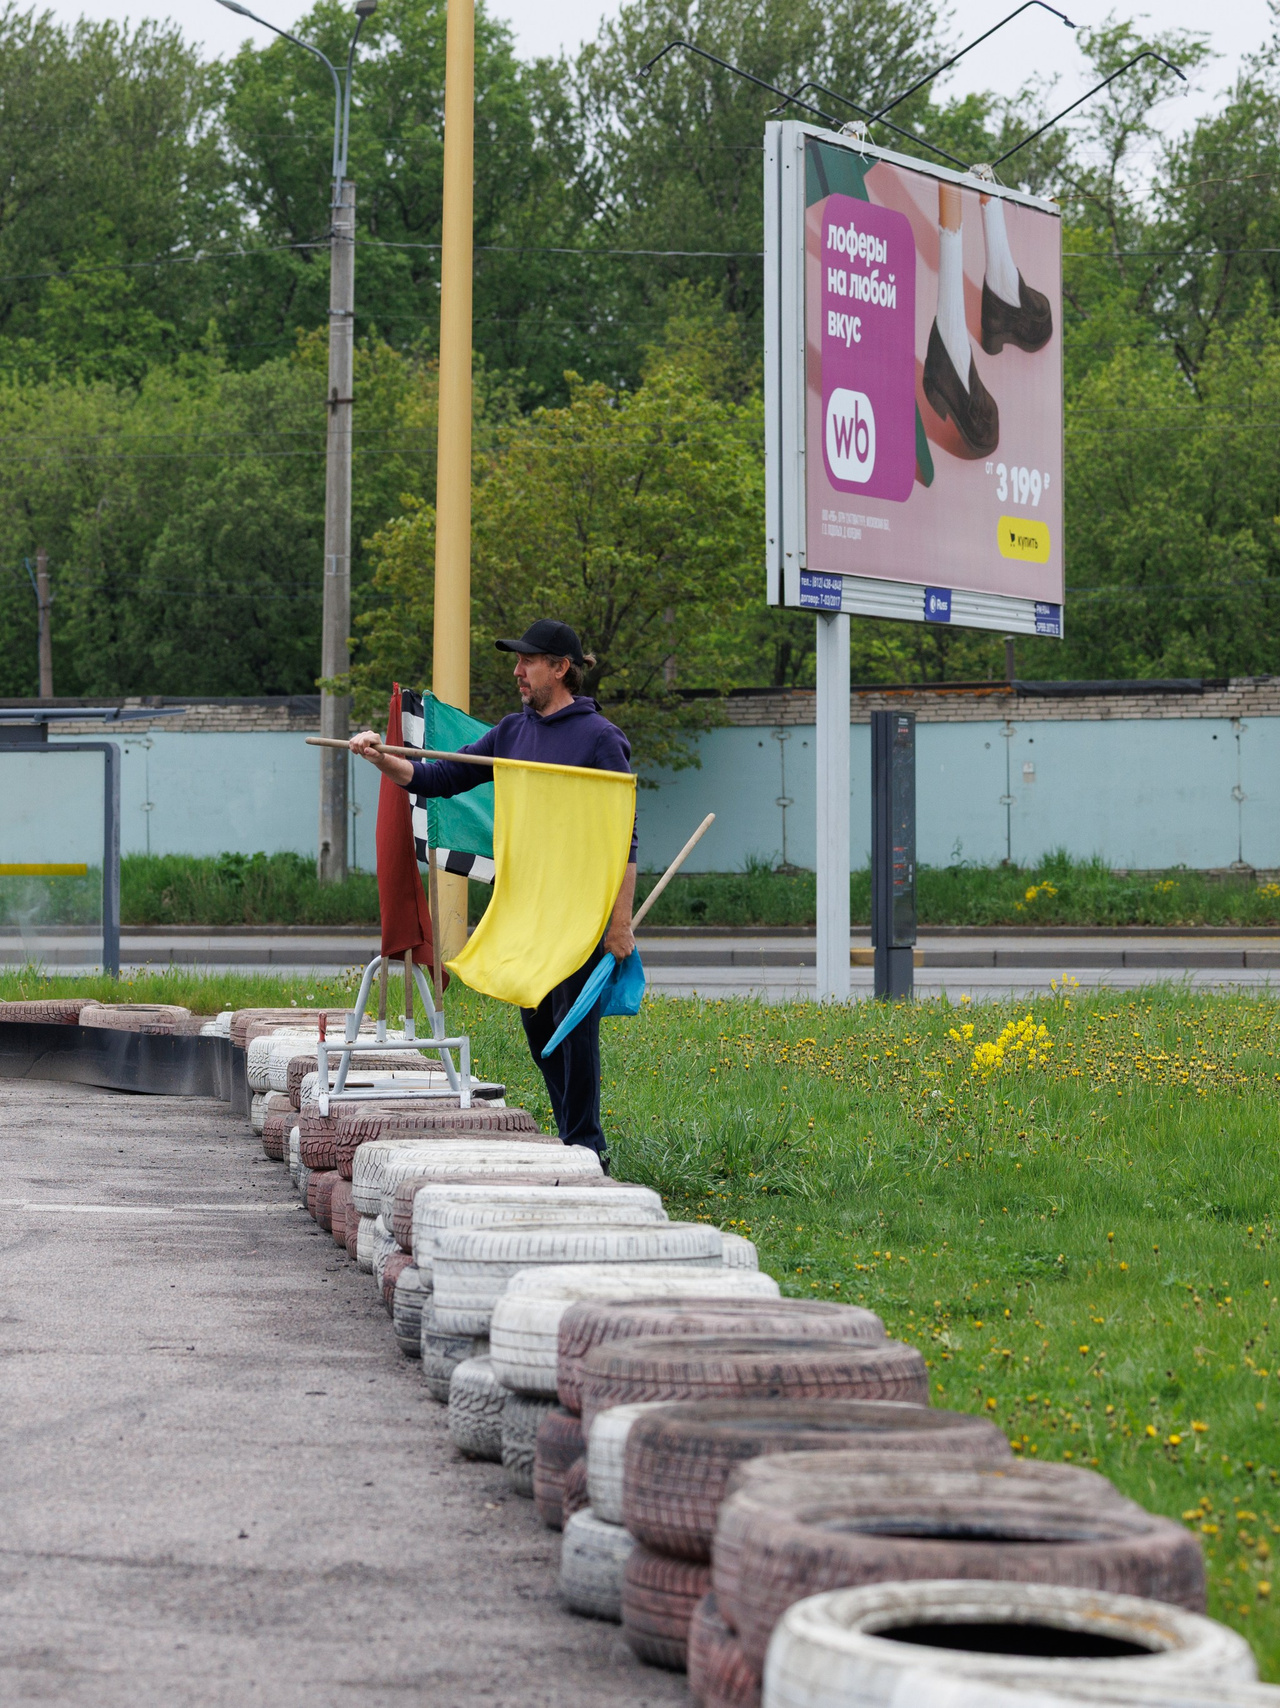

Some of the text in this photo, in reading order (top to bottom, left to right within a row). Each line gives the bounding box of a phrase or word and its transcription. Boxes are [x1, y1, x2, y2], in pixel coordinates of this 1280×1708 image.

[827, 222, 887, 267] лоферы
[827, 267, 897, 309] на любой
[827, 310, 862, 348] вкус
[833, 400, 869, 463] wb
[1017, 536, 1039, 550] купить
